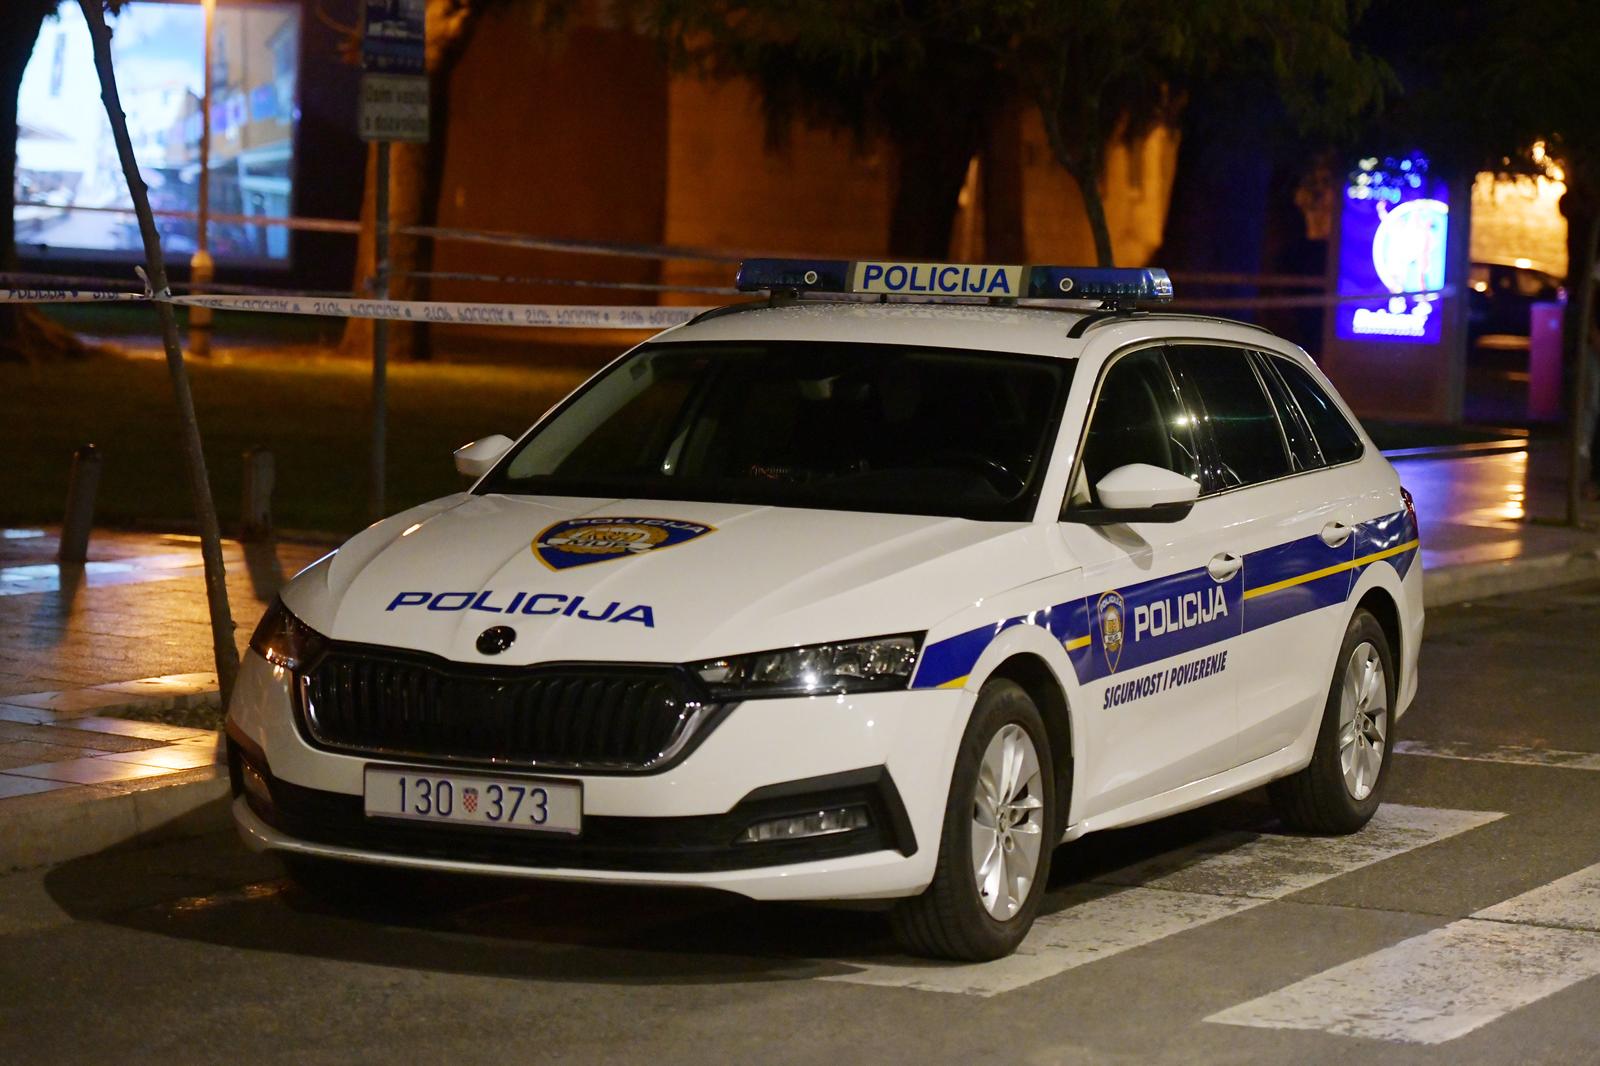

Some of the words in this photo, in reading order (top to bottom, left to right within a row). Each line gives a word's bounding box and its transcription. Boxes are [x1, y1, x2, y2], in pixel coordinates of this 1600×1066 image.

[863, 264, 1010, 294] POLICIJA
[569, 519, 705, 534] POLICIJA
[384, 590, 655, 628] POLICIJA
[1133, 585, 1228, 642] POLICIJA
[1103, 670, 1163, 710] SIGURNOST
[1163, 670, 1169, 691] I
[1169, 650, 1228, 689] POVJERENJE
[399, 777, 453, 816] 130
[485, 784, 548, 825] 373
